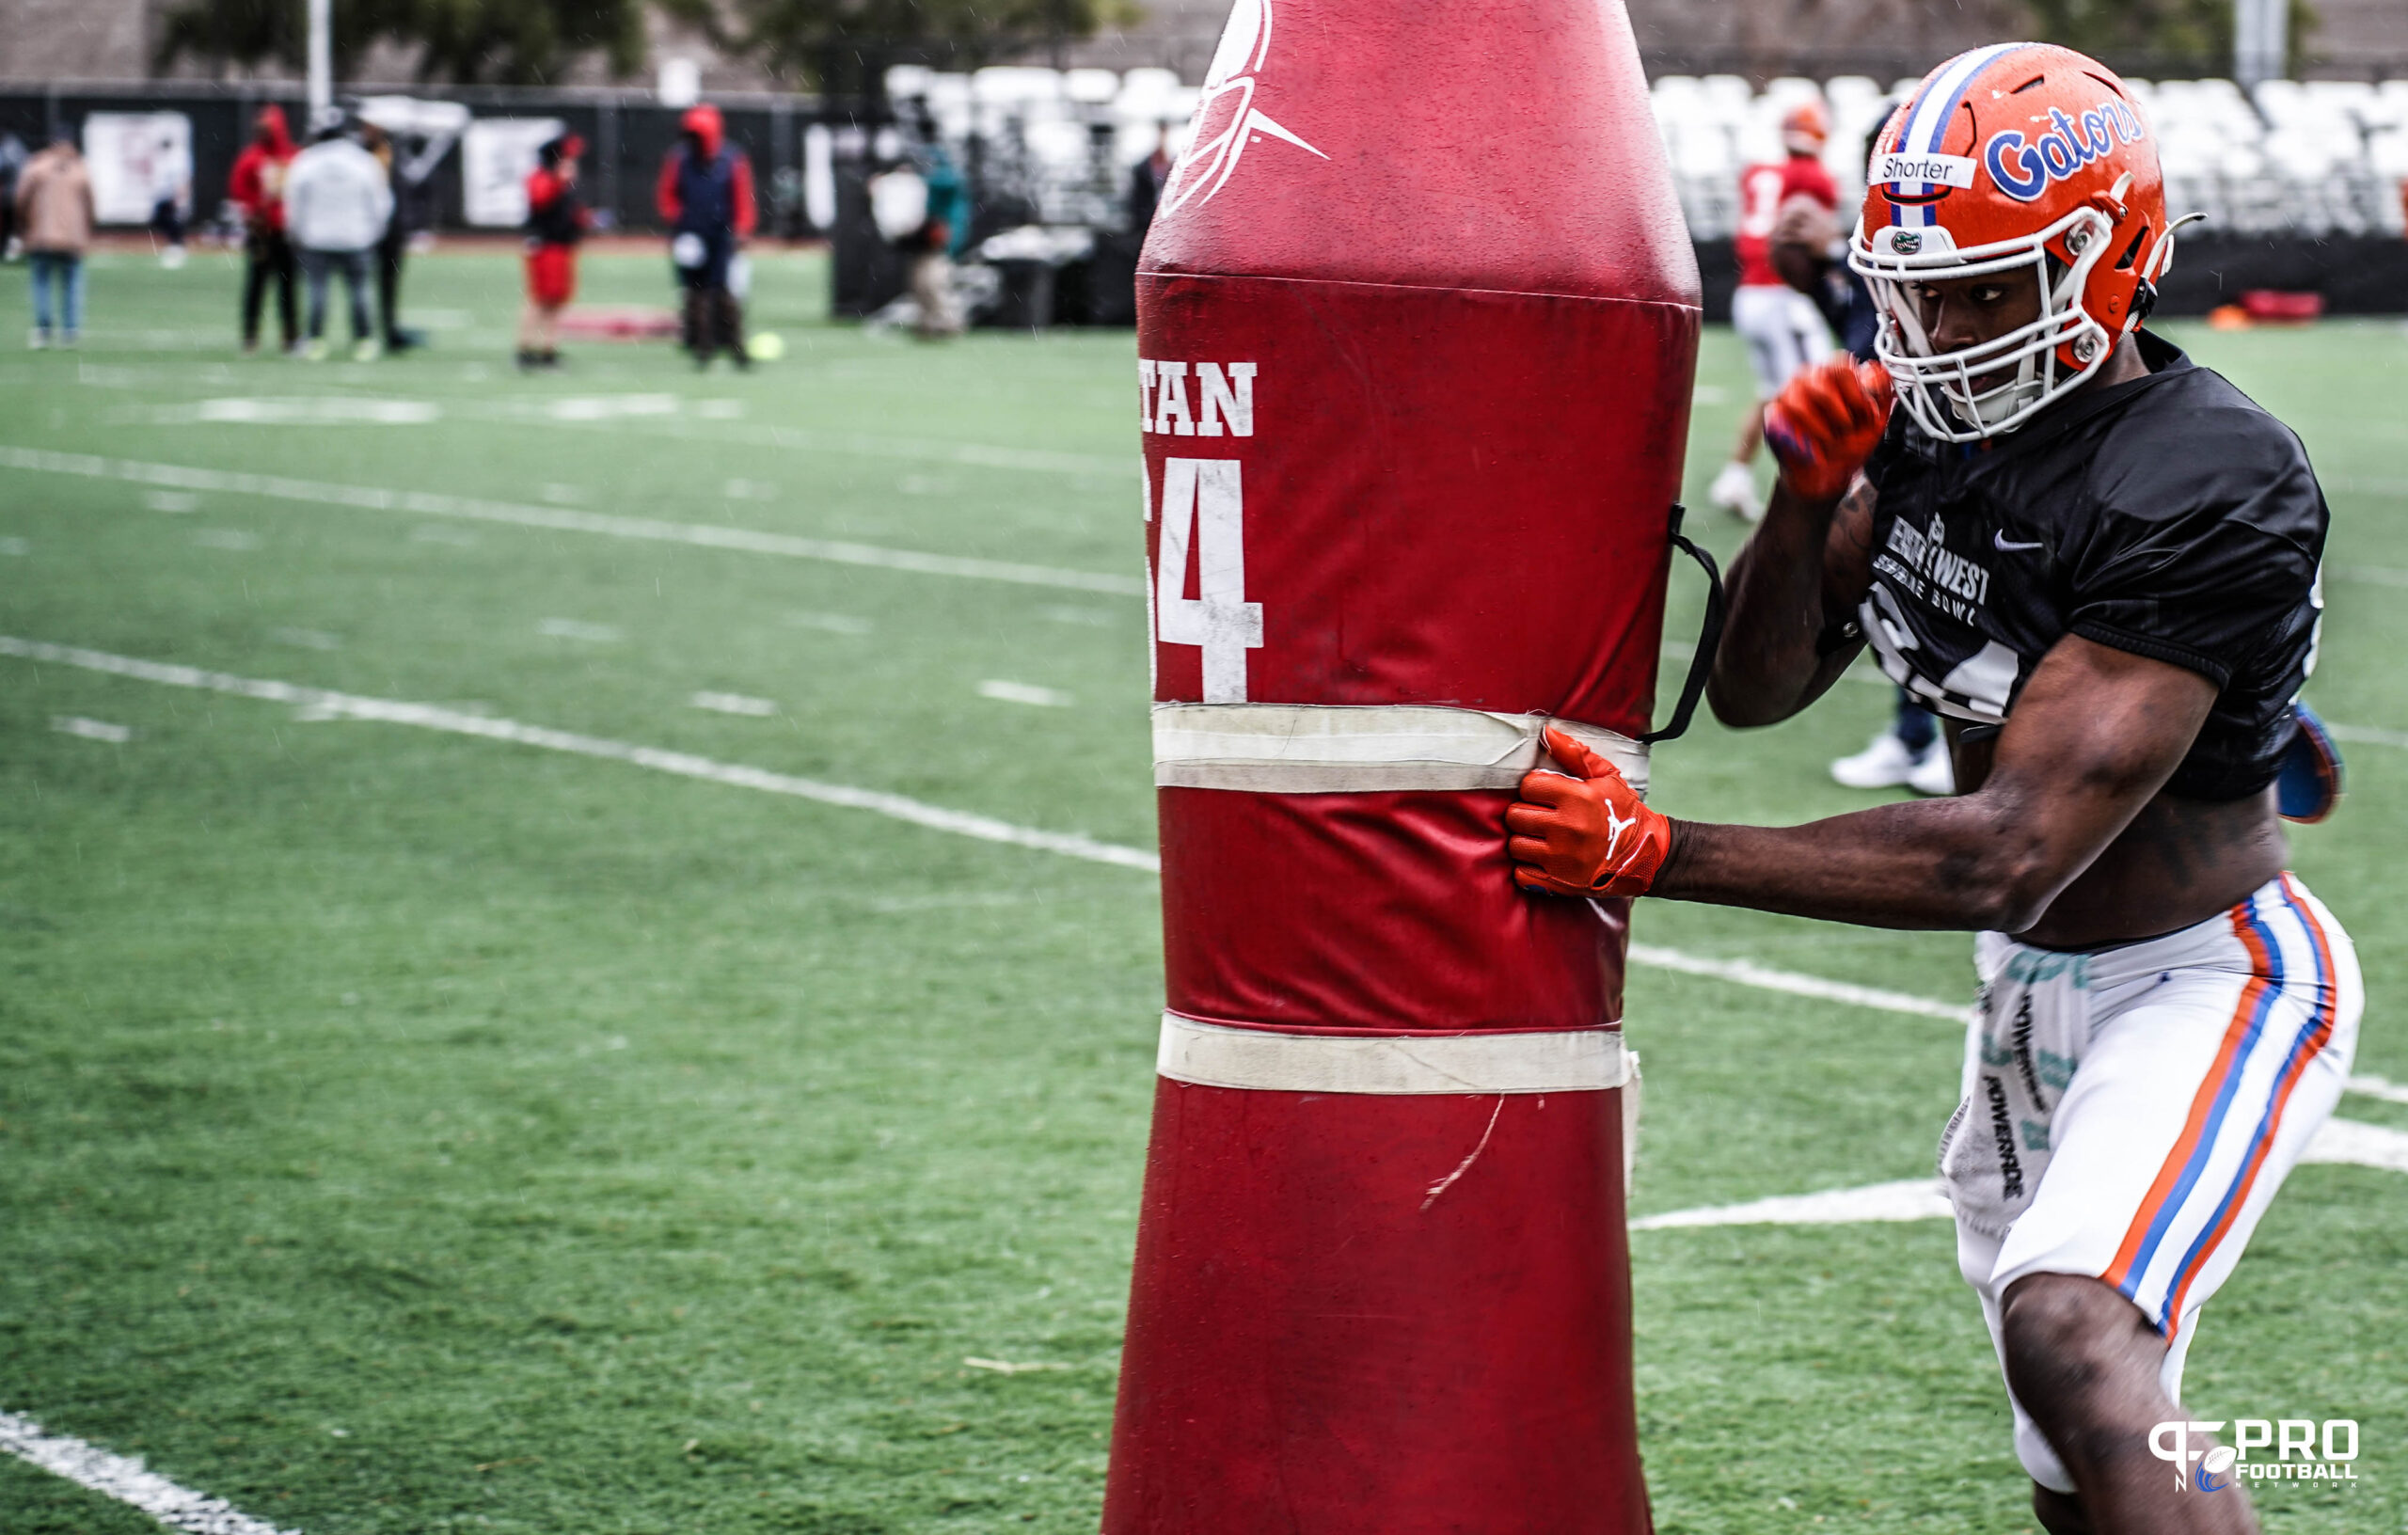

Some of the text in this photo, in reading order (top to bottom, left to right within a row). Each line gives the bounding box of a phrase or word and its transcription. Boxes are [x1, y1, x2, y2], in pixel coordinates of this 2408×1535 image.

[1882, 157, 1953, 181] Shorter
[1985, 95, 2144, 201] Gators
[1142, 453, 1264, 704] 4
[1933, 546, 1990, 606] WEST
